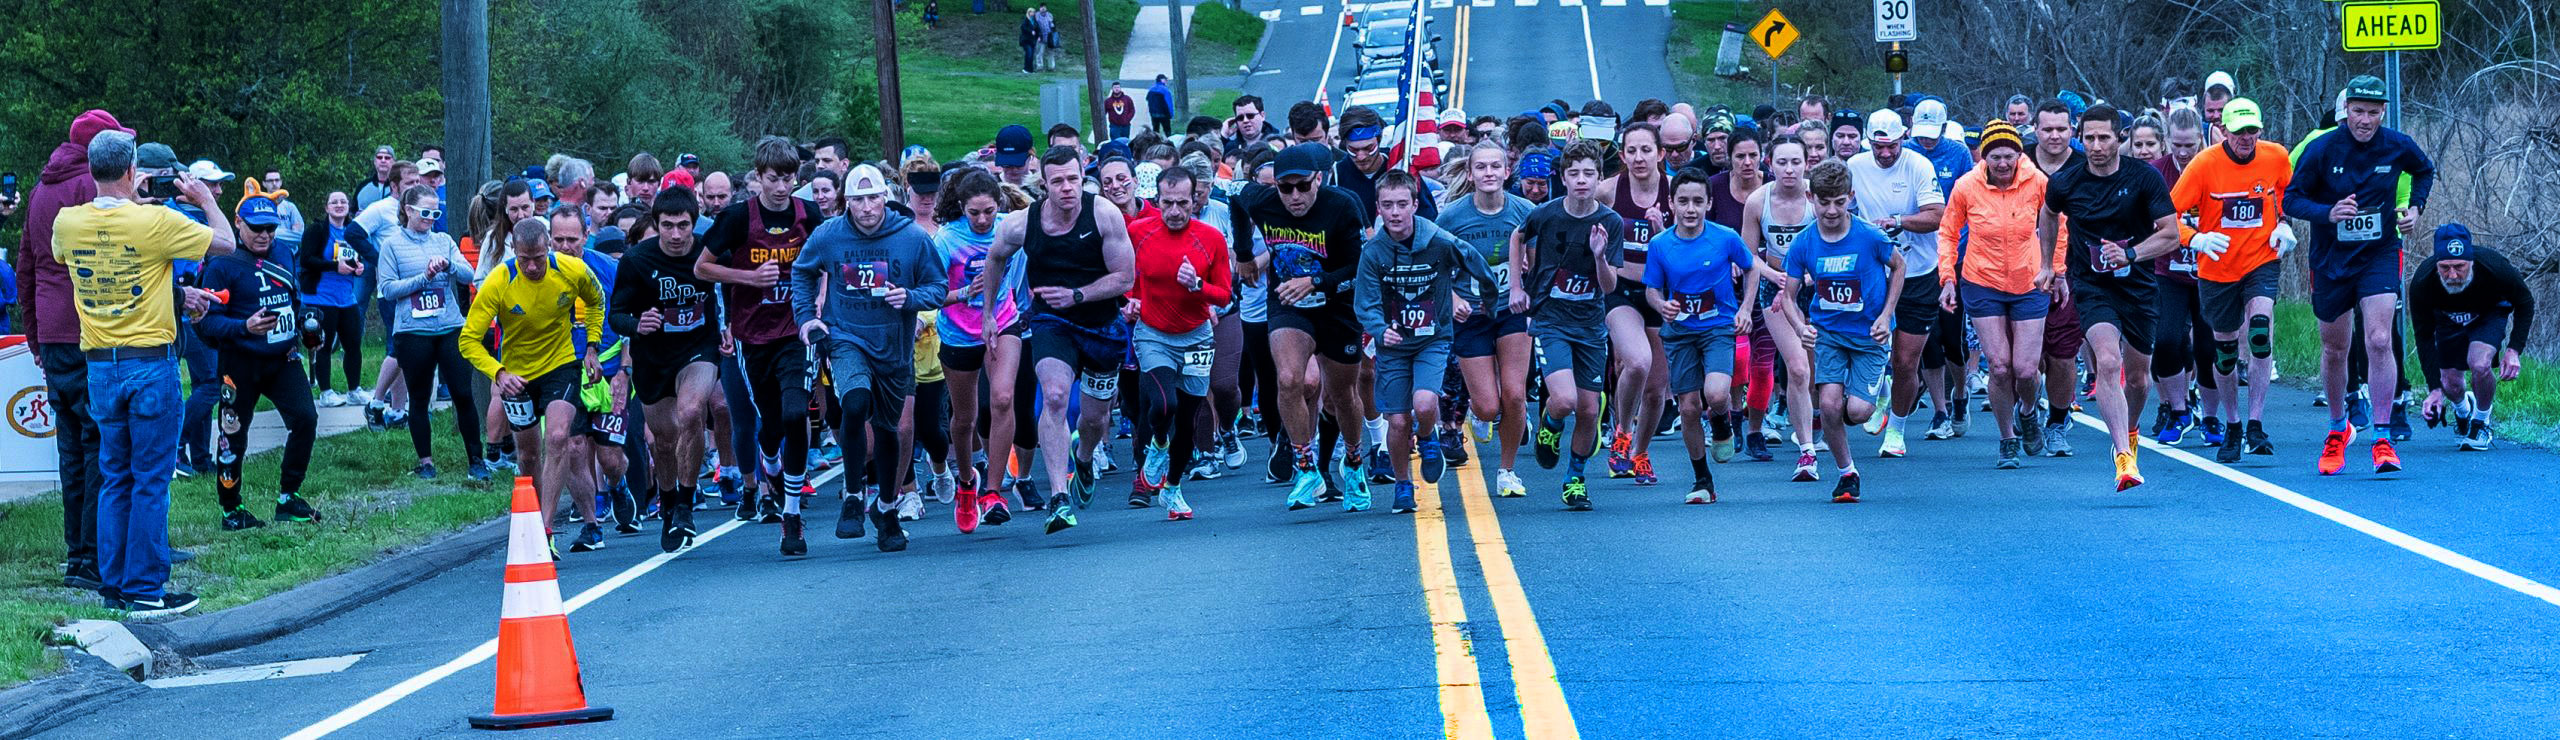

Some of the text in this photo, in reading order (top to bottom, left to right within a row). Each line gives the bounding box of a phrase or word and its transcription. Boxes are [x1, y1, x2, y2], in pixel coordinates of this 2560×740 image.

[1881, 0, 1909, 20] 30
[2356, 14, 2427, 37] AHEAD
[2231, 205, 2255, 219] 180
[2344, 215, 2374, 231] 806
[1466, 232, 1488, 240] FARM
[1490, 230, 1501, 238] TO
[1633, 227, 1649, 242] 18
[1295, 228, 1328, 258] DEATH
[750, 247, 801, 264] GRANB
[843, 248, 890, 259] BALTIMORE
[1823, 256, 1852, 273] NIKE
[254, 271, 272, 292] 1
[858, 269, 876, 287] 22
[1565, 278, 1590, 293] 161
[418, 294, 440, 309] 188
[1828, 286, 1853, 302] 169
[1685, 299, 1702, 313] 37
[677, 311, 694, 325] 82
[1401, 309, 1426, 327] 199
[1087, 378, 1115, 391] 866
[600, 413, 623, 433] 128
